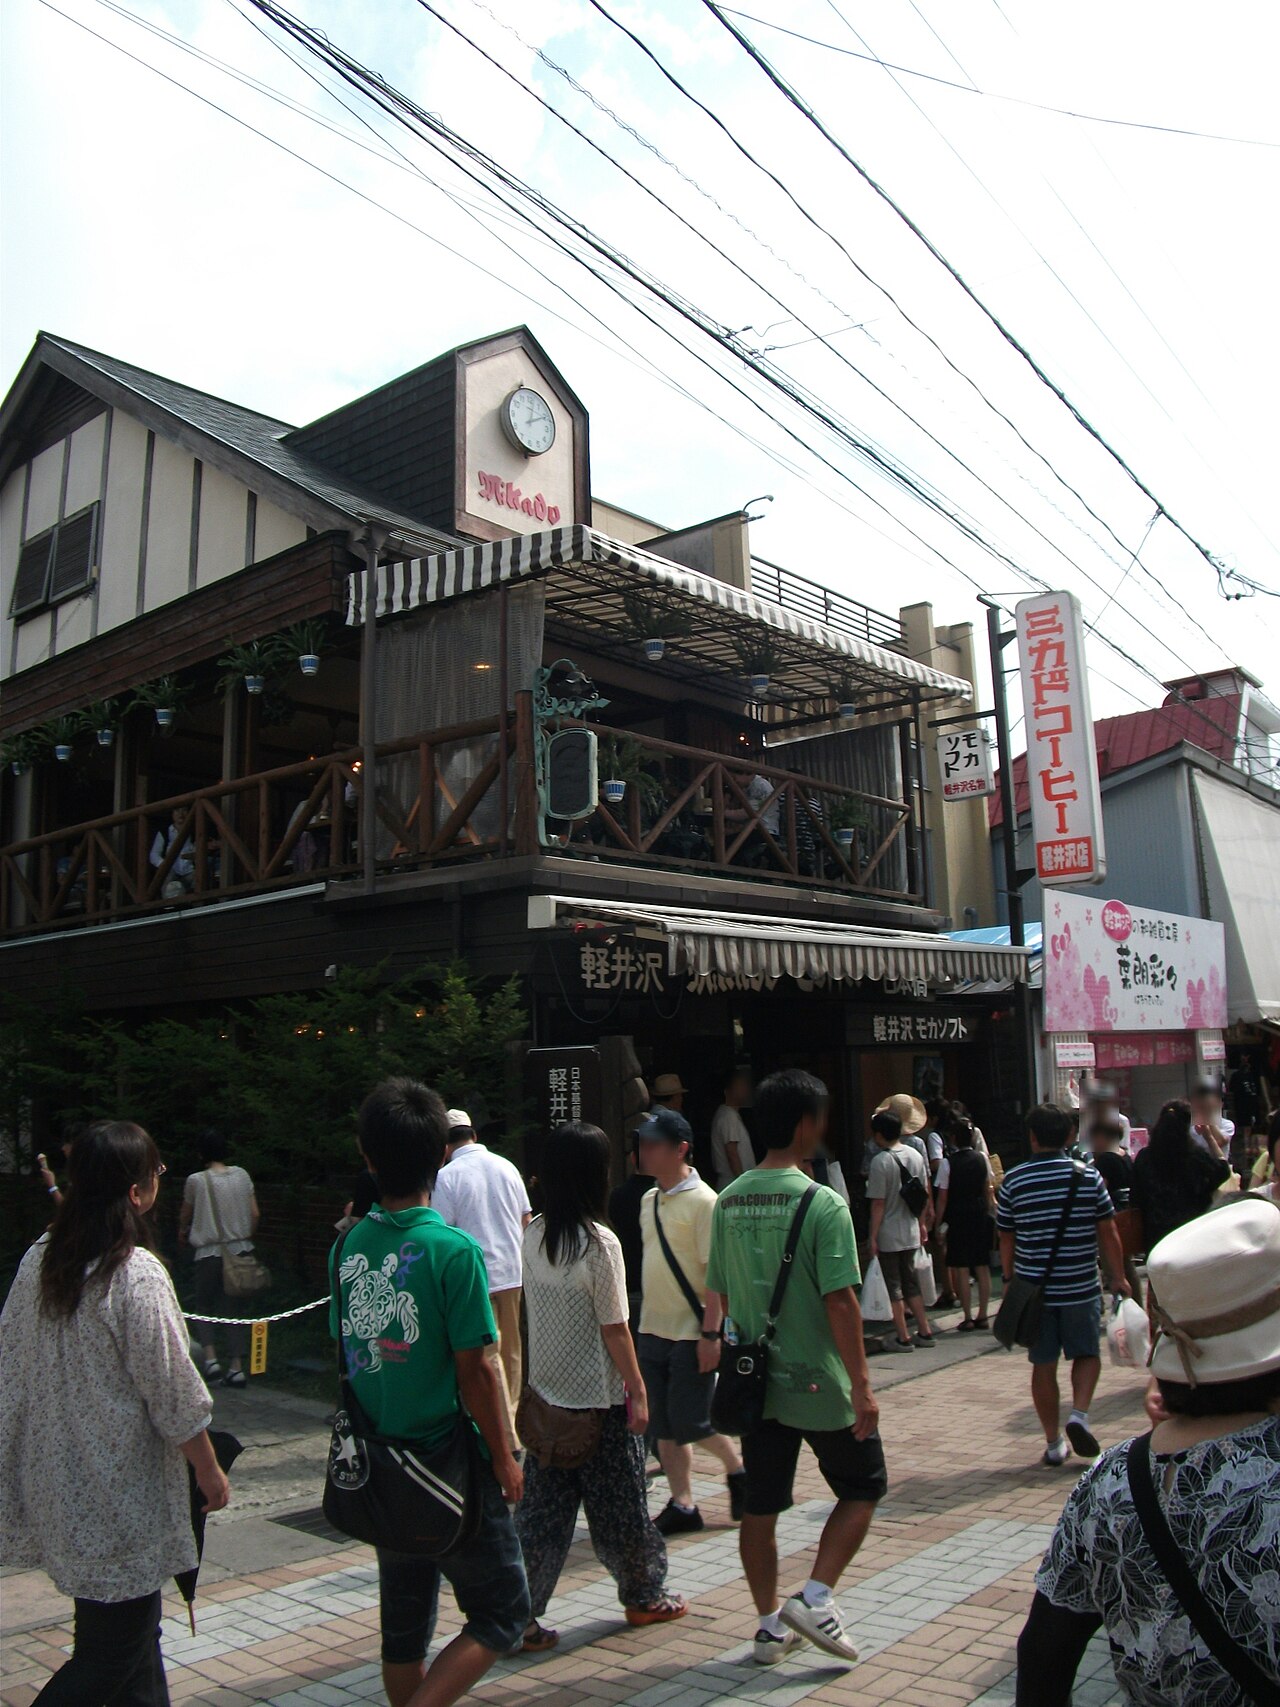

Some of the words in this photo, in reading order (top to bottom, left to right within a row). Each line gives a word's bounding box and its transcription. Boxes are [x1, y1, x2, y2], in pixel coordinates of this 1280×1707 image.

[477, 470, 562, 526] Mikado
[1025, 604, 1078, 834] ミカドコーヒー
[944, 736, 961, 778] ソフト
[962, 732, 979, 768] モカ
[1041, 841, 1089, 872] 軽井沢店
[579, 941, 664, 993] 軽井沢
[872, 1015, 914, 1042] 軽井沢
[916, 1016, 968, 1040] モカソフト
